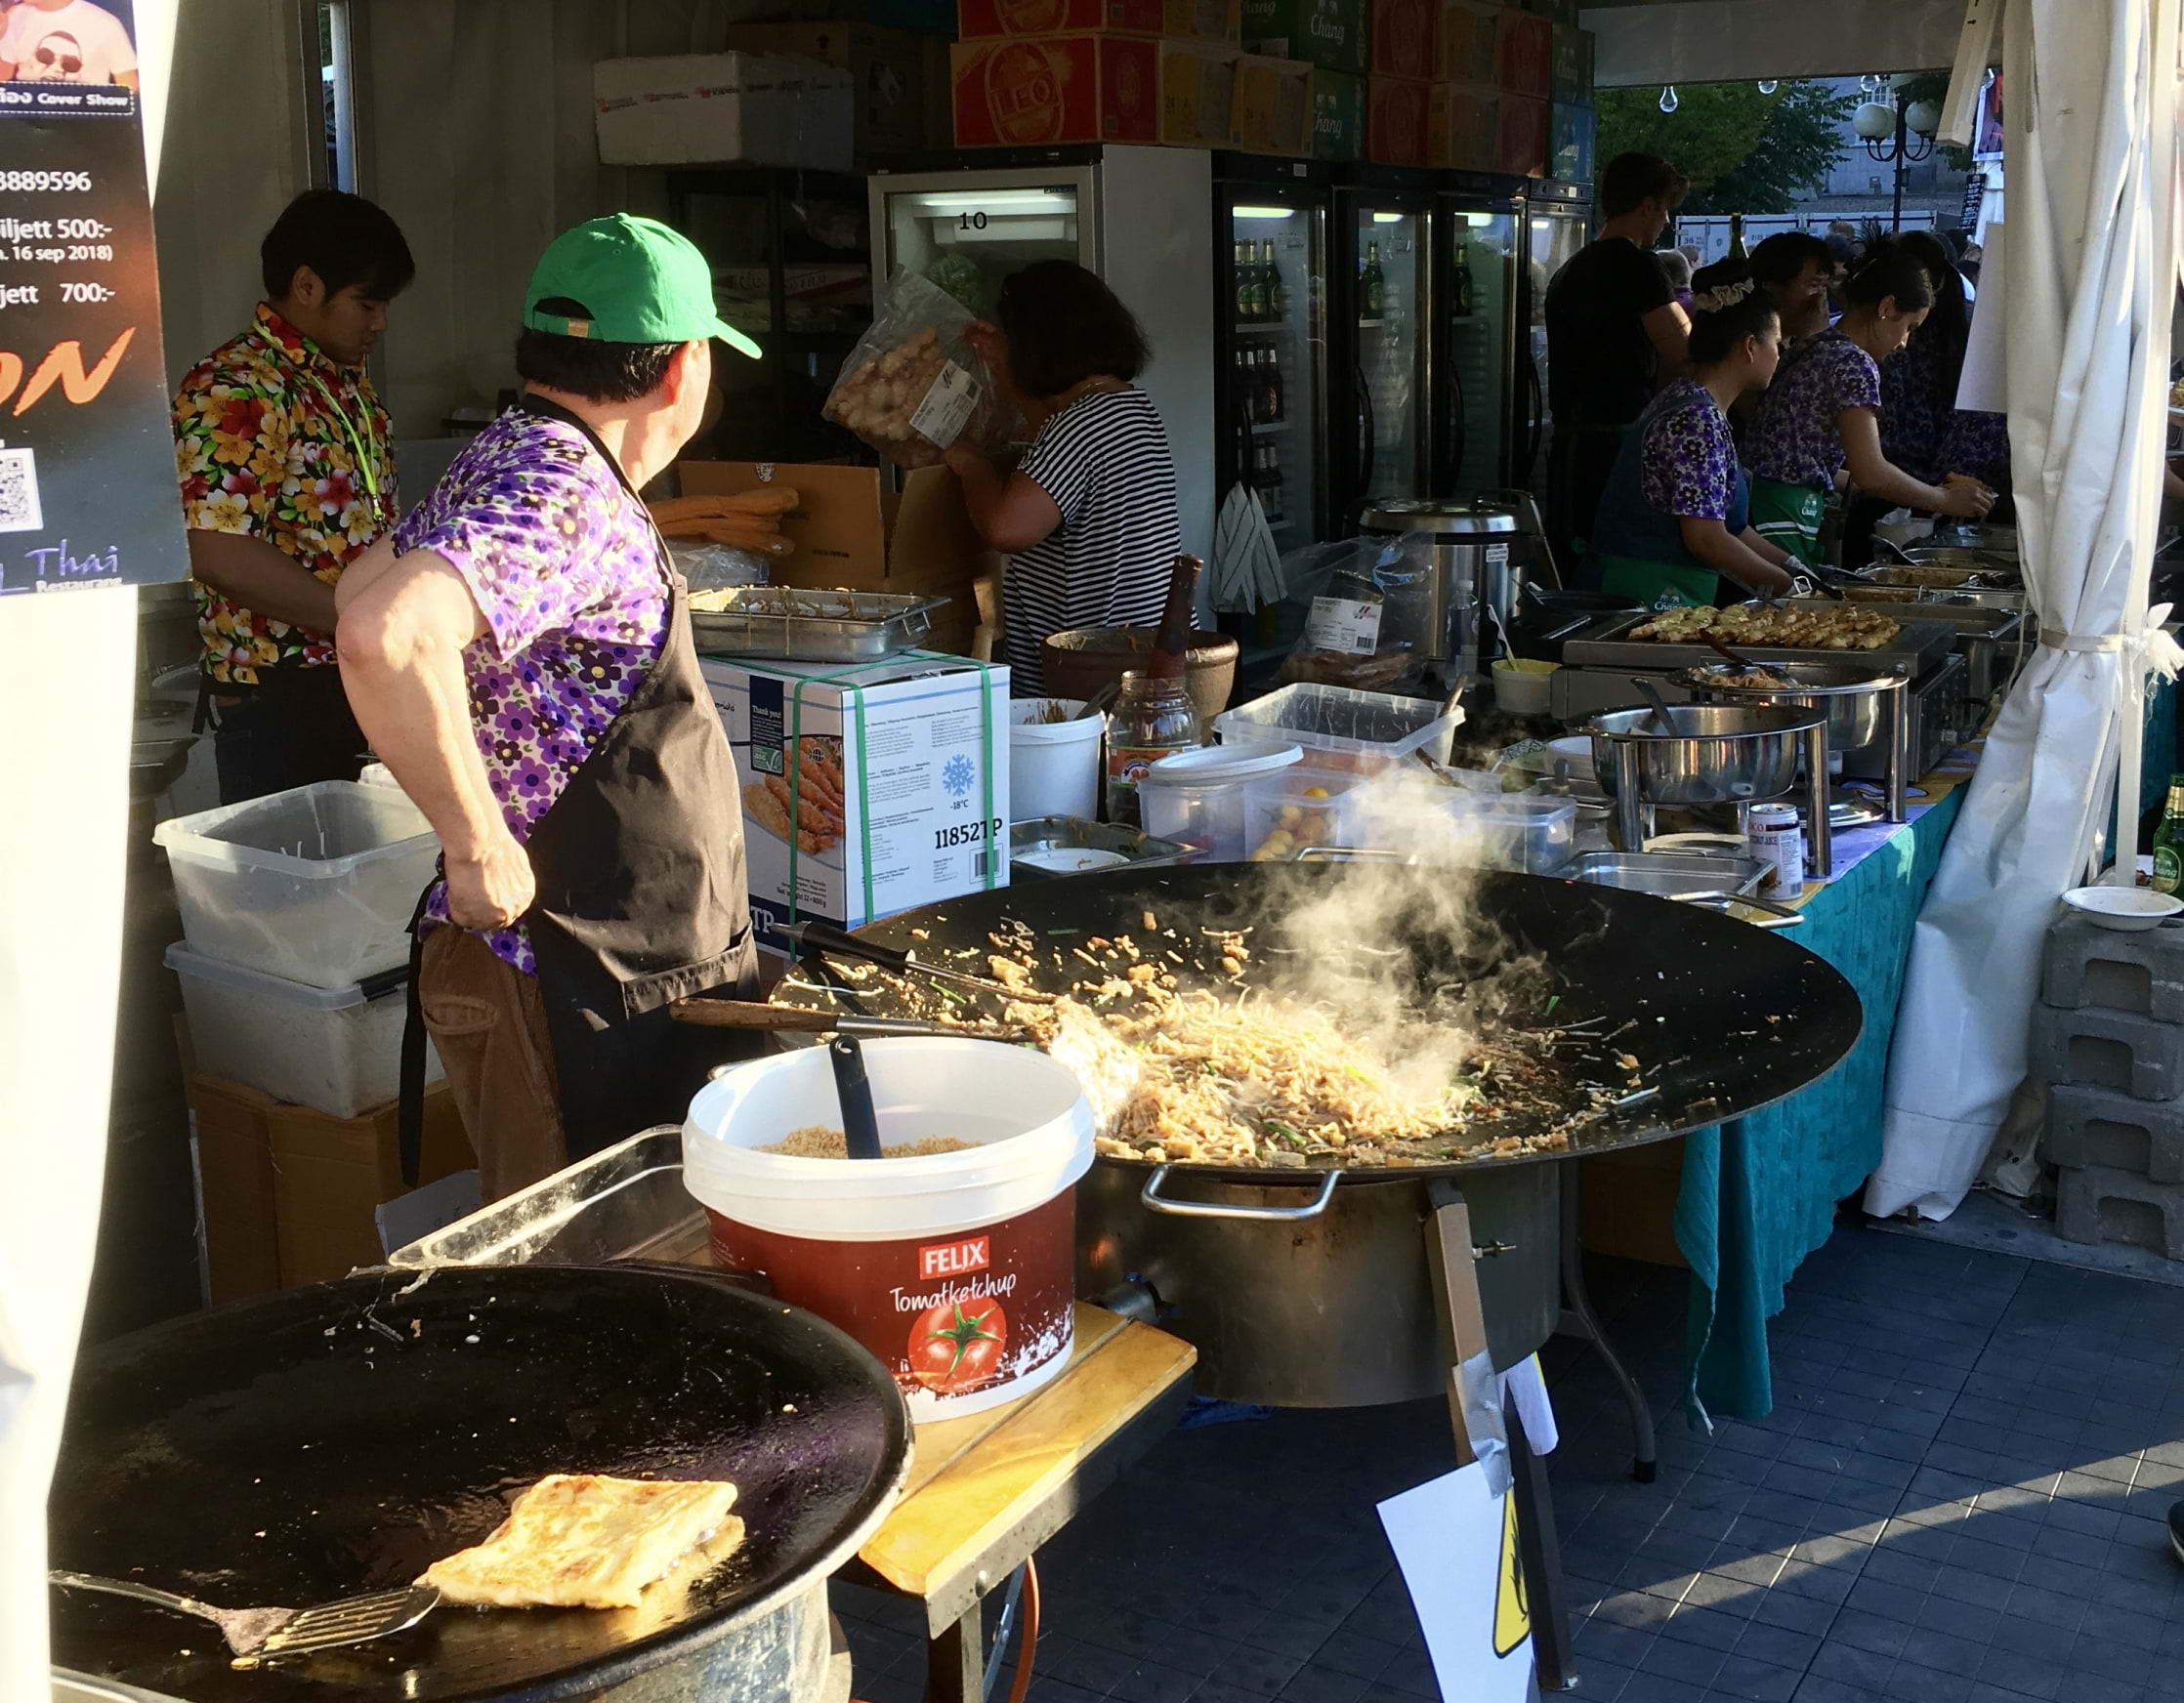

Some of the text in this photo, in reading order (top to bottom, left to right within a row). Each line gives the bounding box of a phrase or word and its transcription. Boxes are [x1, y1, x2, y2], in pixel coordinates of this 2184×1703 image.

[1242, 0, 1276, 16] hang
[1311, 14, 1345, 46] Chang
[37, 93, 82, 104] Cover
[86, 94, 128, 105] Show
[994, 75, 1054, 117] LEO
[57, 219, 112, 239] 500:-
[959, 212, 987, 229] 10
[12, 246, 32, 261] 16
[35, 248, 65, 264] sep
[67, 245, 113, 262] 2018)
[60, 282, 115, 303] 700:-
[24, 539, 118, 576] Thai
[752, 704, 770, 717] Thank
[949, 799, 969, 810] -18°C
[2155, 863, 2177, 878] hang
[925, 1240, 985, 1274] FELIX
[889, 1272, 1017, 1312] Tomatketchup
